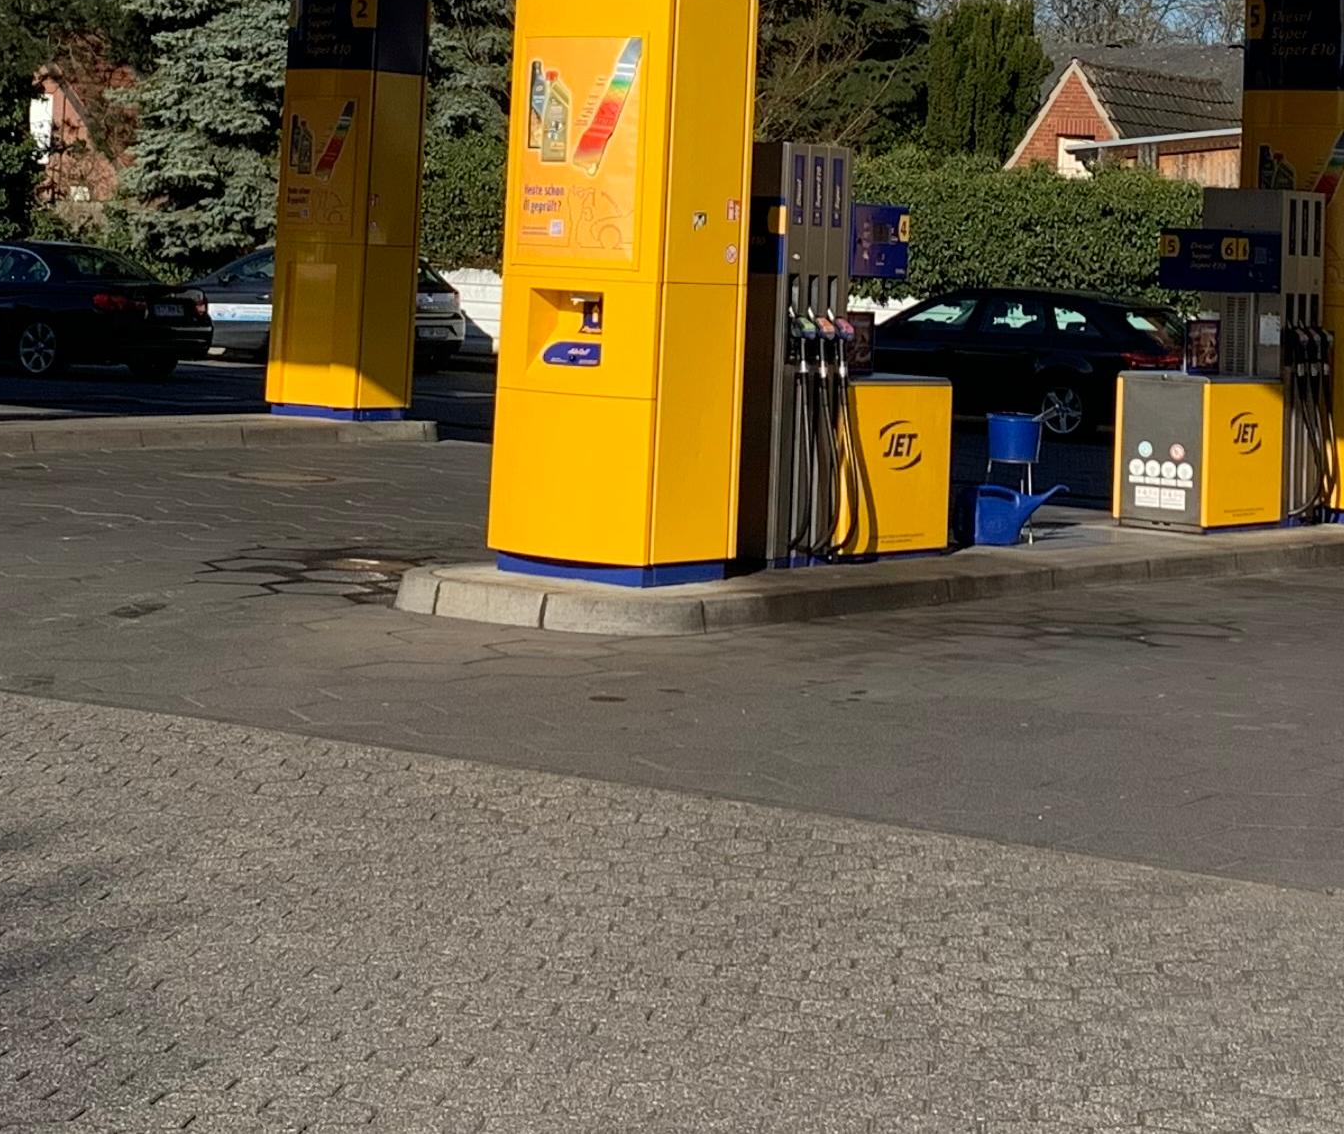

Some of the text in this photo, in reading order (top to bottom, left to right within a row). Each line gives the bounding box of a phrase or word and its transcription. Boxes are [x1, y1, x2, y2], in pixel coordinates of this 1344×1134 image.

[356, 0, 368, 18] 2
[1250, 5, 1260, 28] 5
[1271, 27, 1308, 41] Super
[1271, 43, 1336, 58] Super E10
[901, 220, 907, 237] 4
[1167, 239, 1176, 254] 5
[1224, 242, 1234, 256] 6
[1233, 423, 1259, 444] JET
[882, 433, 919, 458] JET
